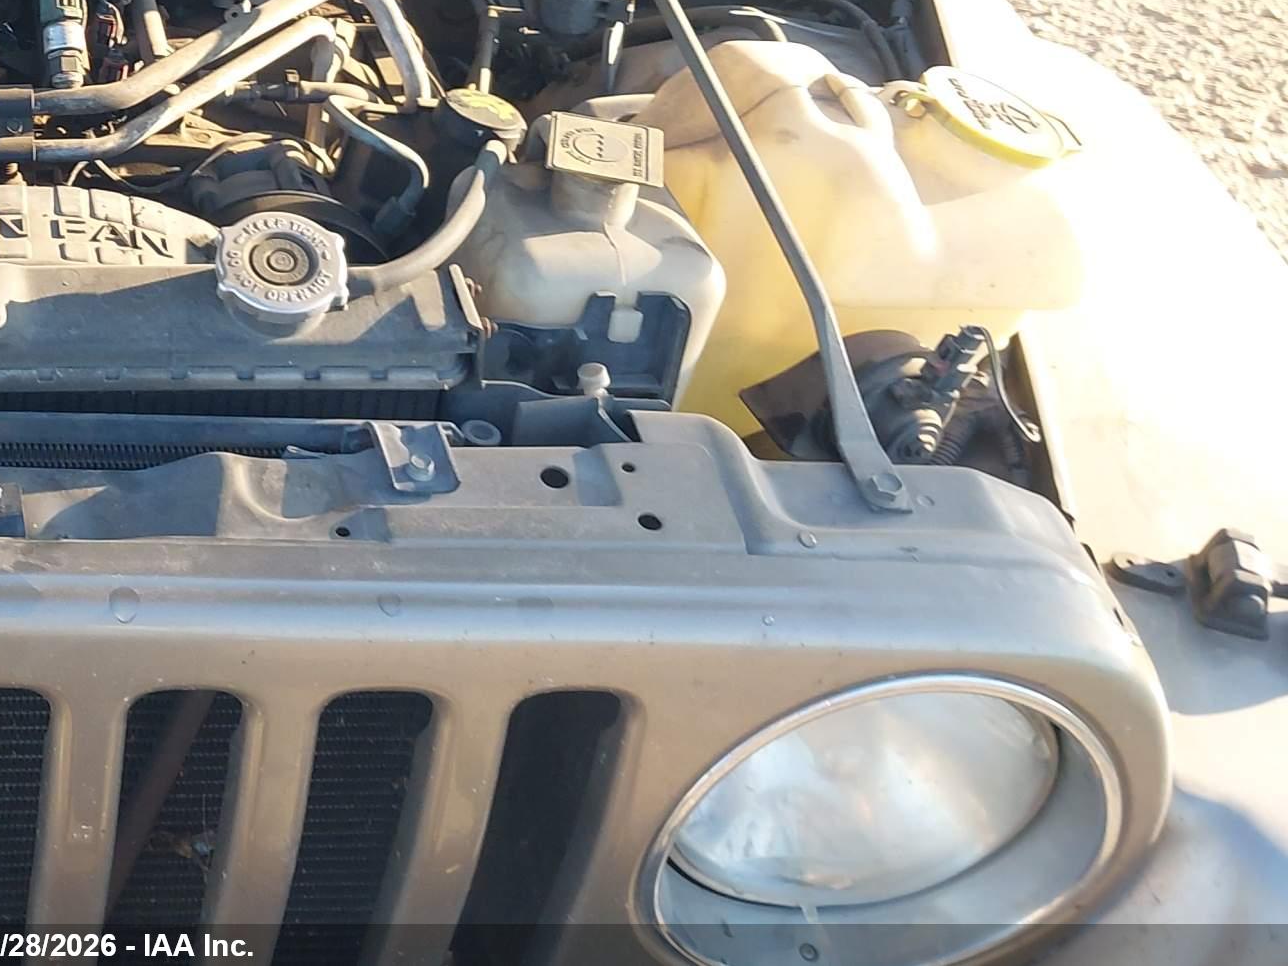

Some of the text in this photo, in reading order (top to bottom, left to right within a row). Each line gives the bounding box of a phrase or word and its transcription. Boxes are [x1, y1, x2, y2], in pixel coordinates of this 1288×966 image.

[49, 218, 174, 259] FAN
[264, 288, 308, 303] OPEN
[306, 270, 333, 298] HOT
